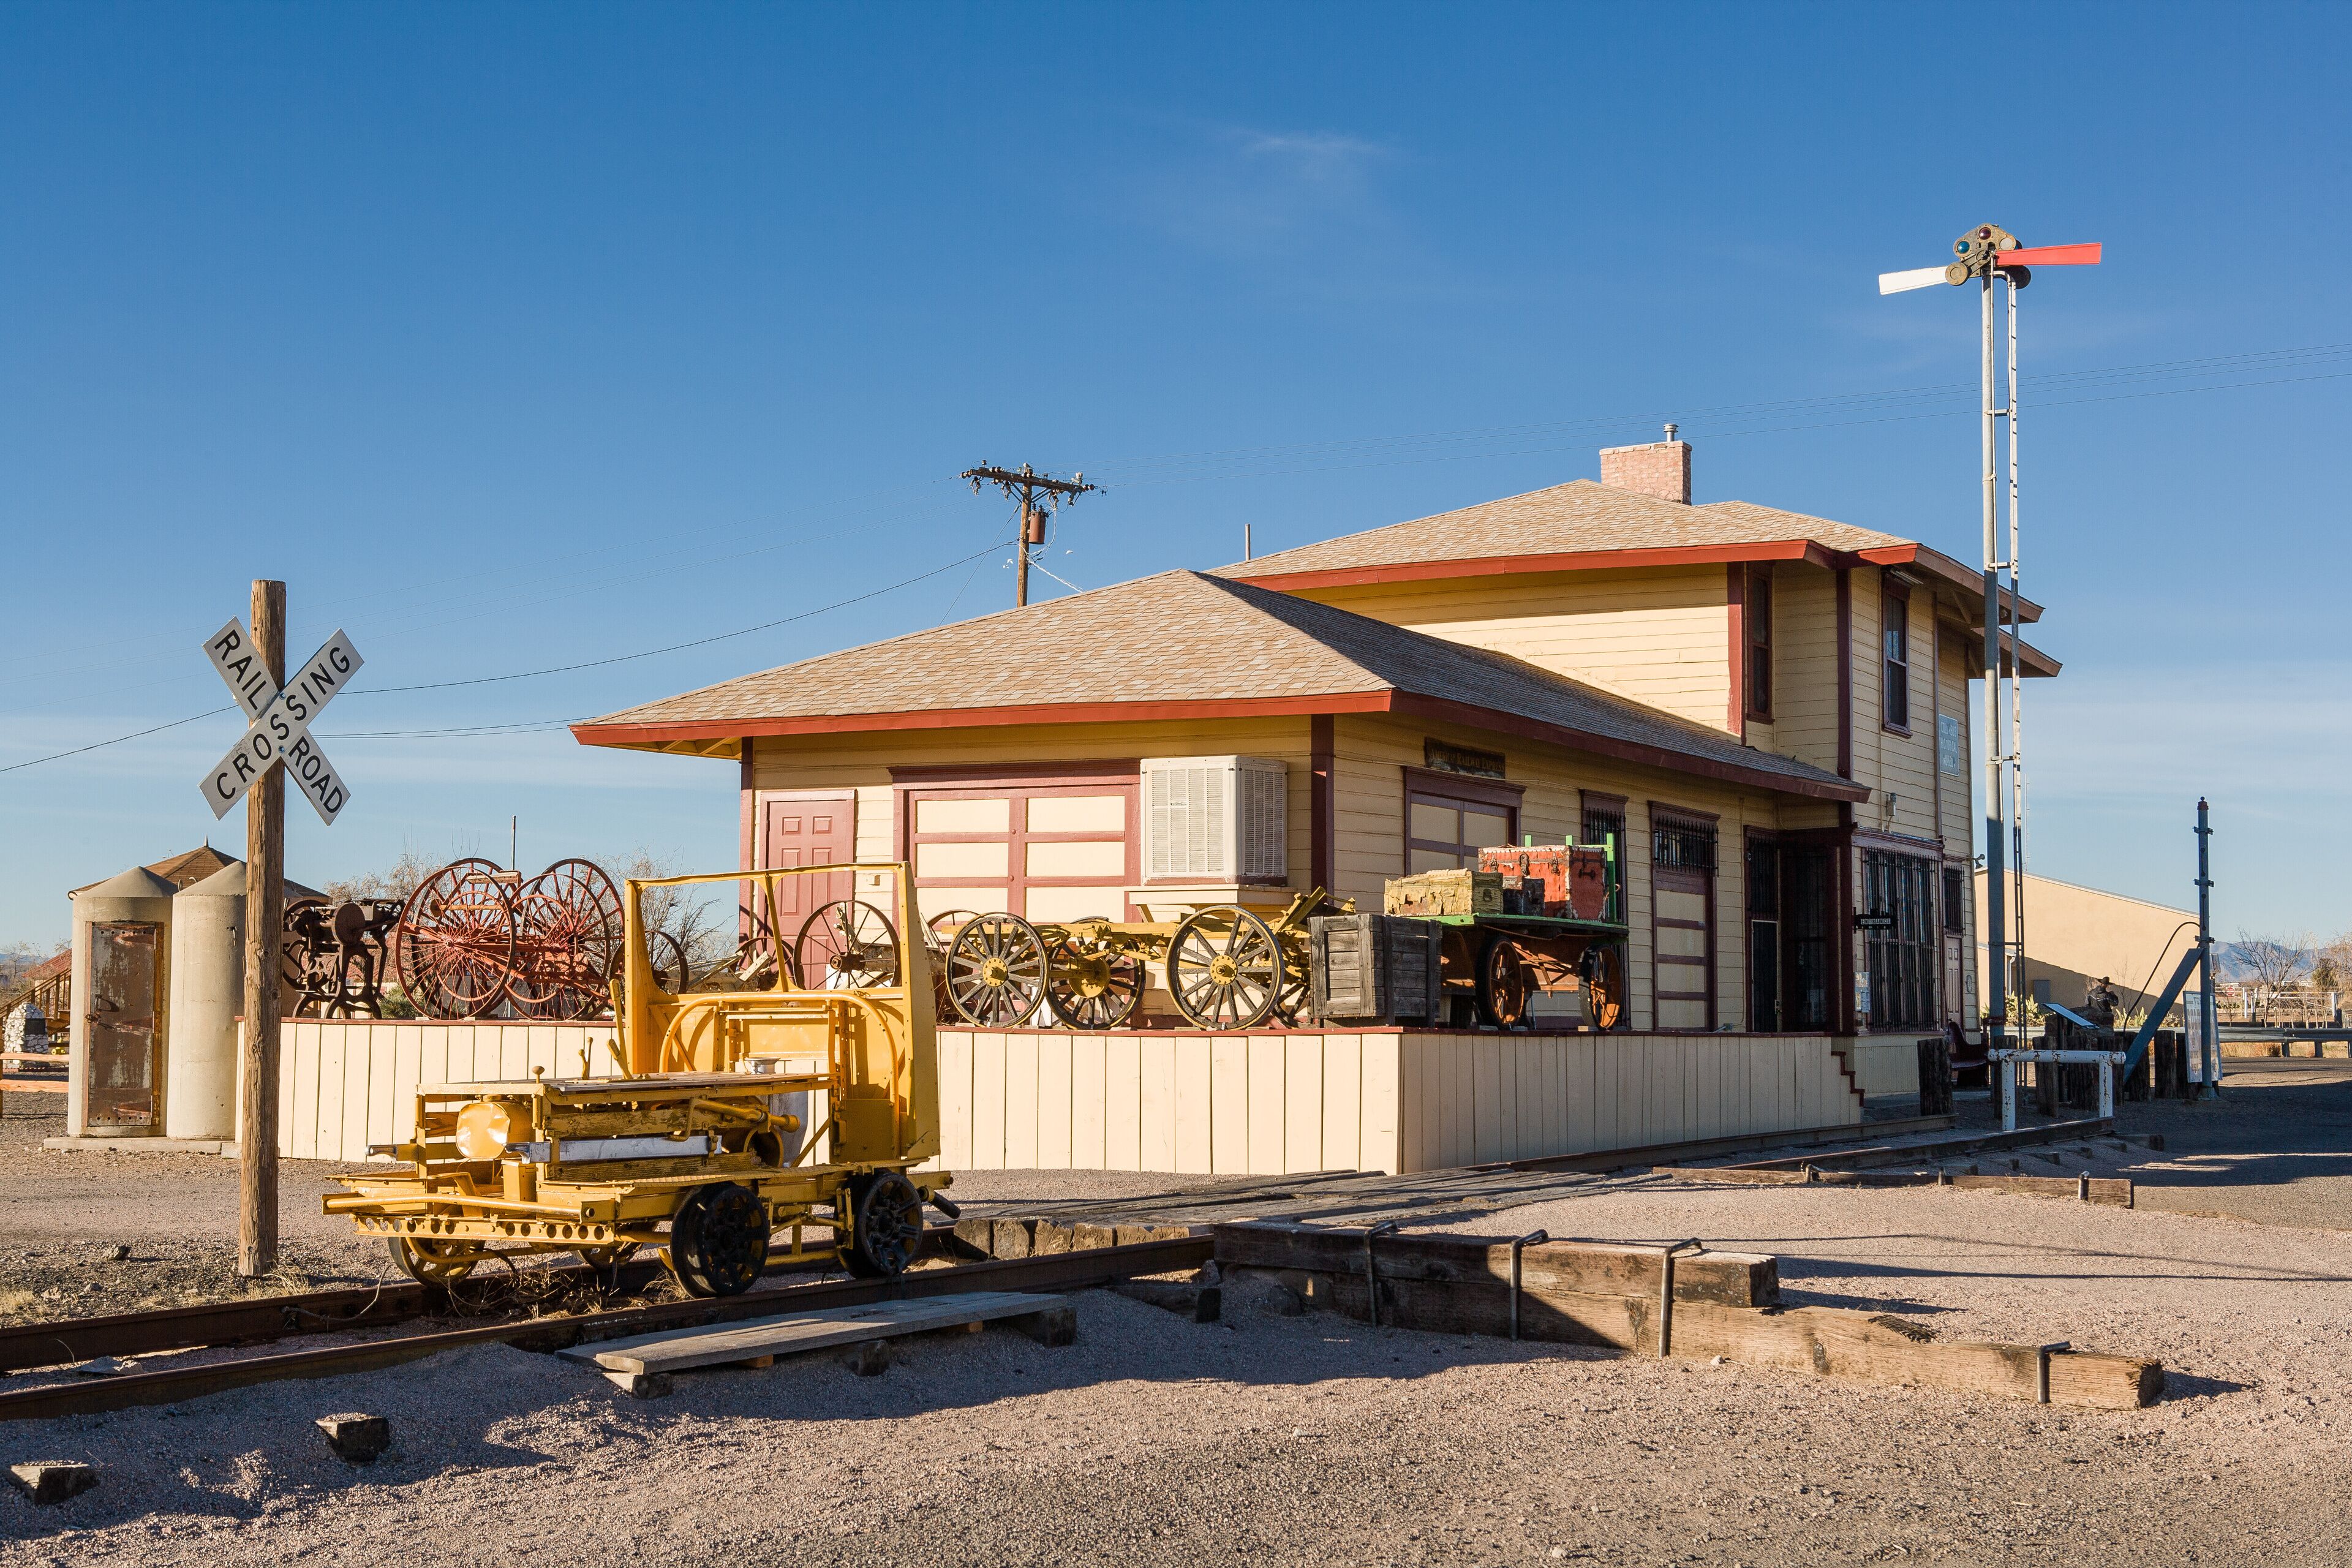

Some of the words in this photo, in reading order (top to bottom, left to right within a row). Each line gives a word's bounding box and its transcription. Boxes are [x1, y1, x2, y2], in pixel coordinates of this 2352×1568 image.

[214, 629, 266, 710] RAIL
[288, 737, 342, 813] ROAD
[216, 647, 350, 799] CROSSING
